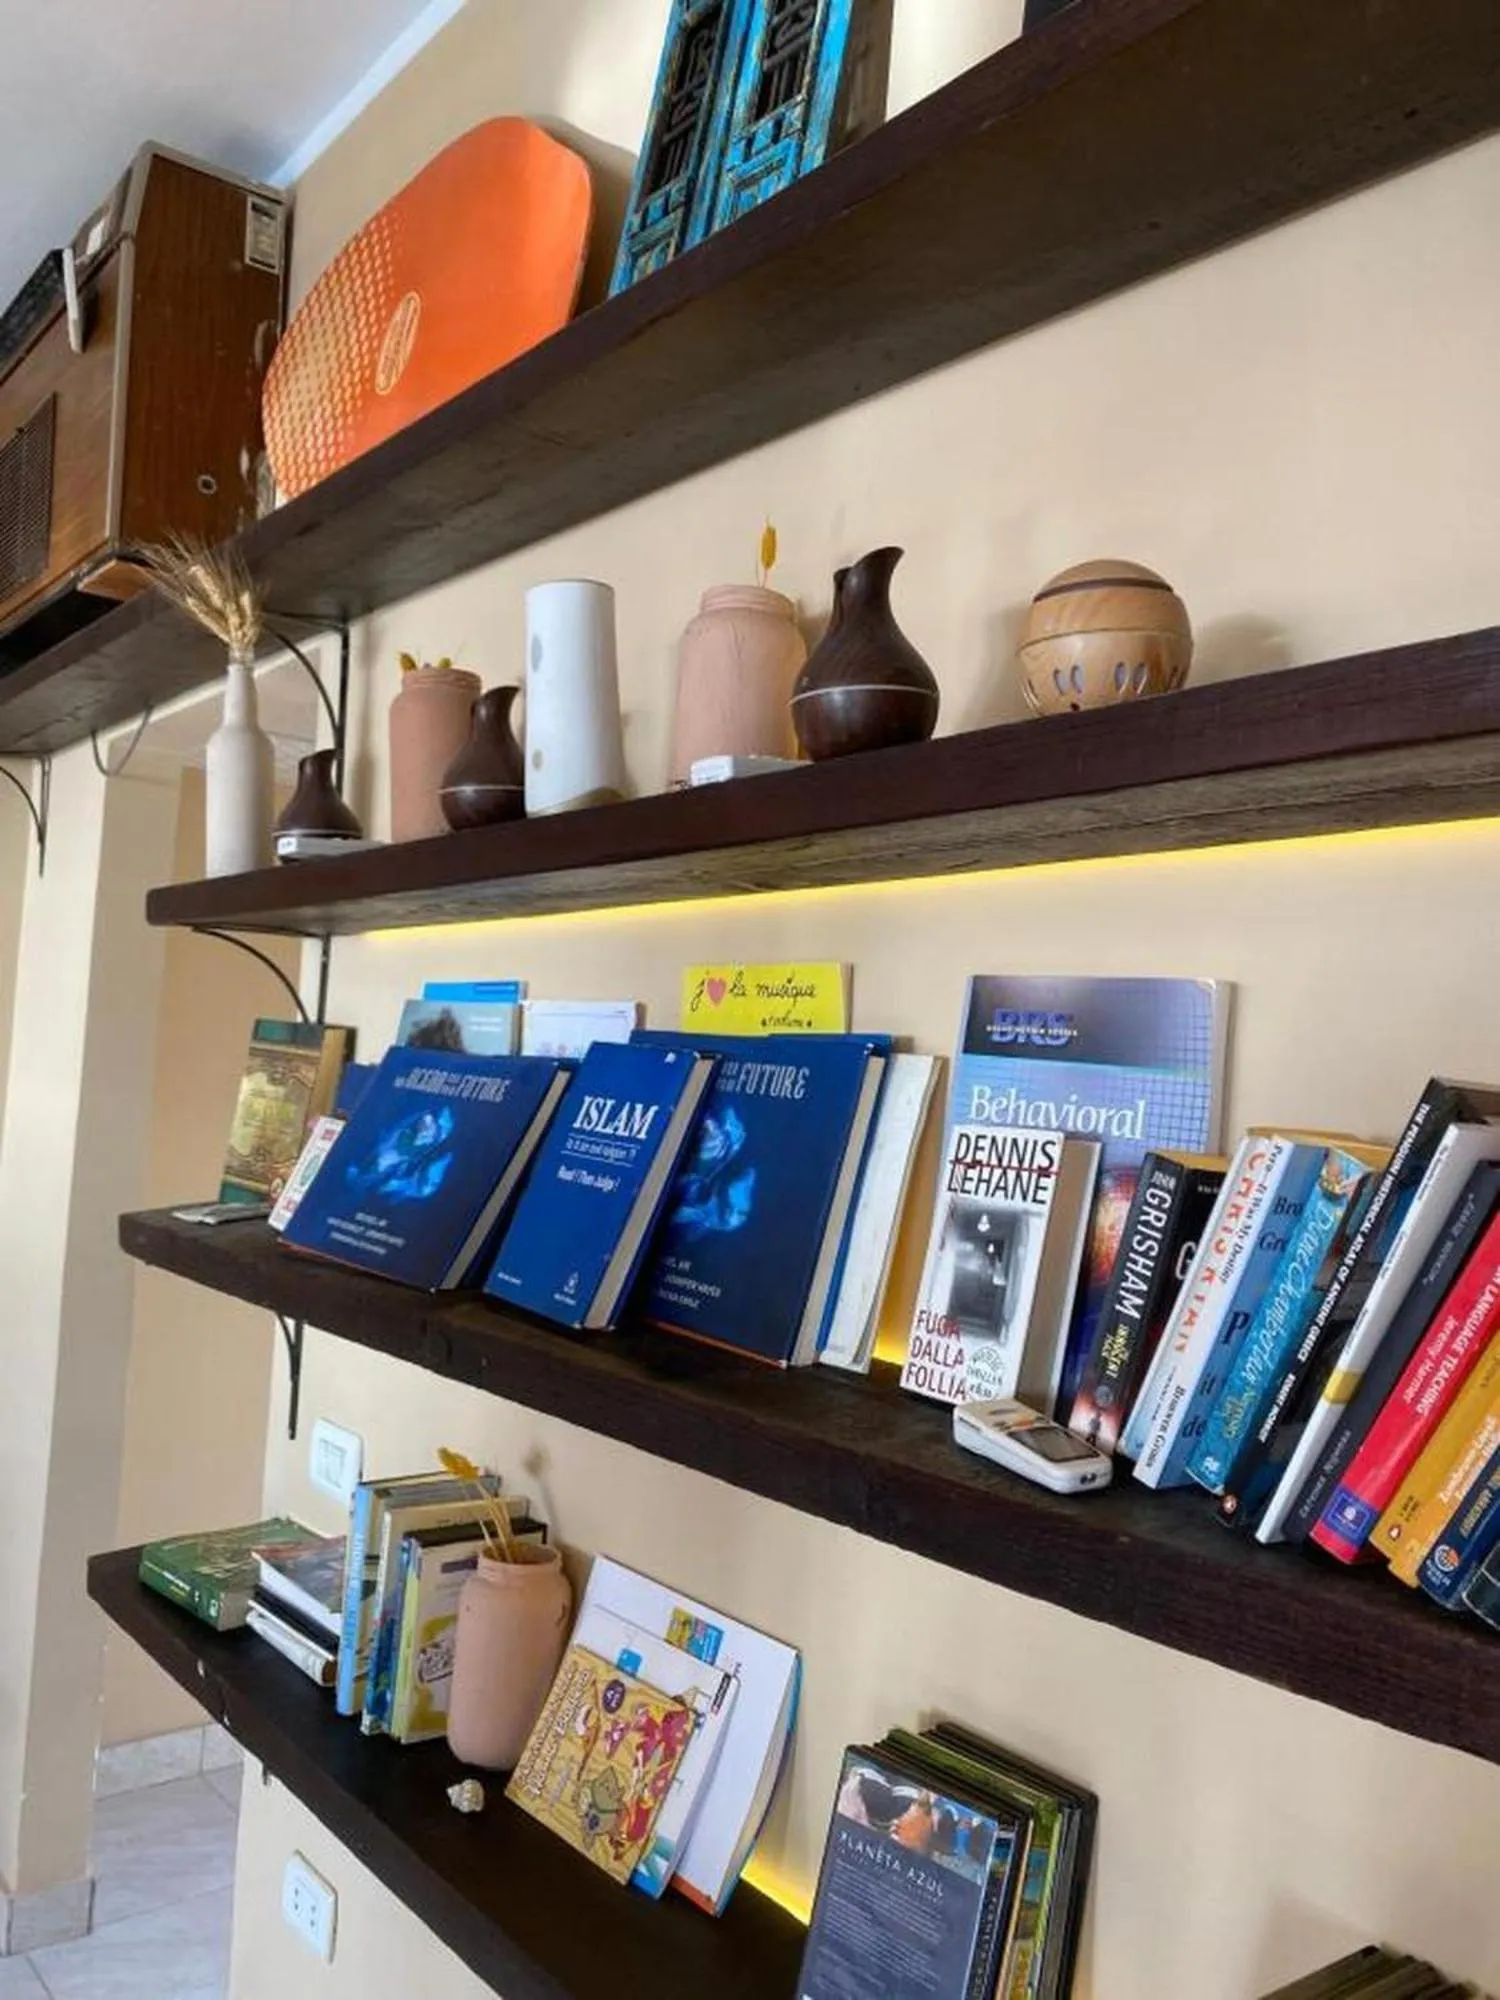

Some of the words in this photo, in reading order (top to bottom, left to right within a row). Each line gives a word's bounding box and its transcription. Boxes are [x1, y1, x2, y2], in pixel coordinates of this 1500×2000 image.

[735, 1061, 810, 1100] FUTURE
[572, 1095, 659, 1139] ISLAM
[969, 1084, 1147, 1140] Behavioral
[1413, 1102, 1431, 1124] THE
[954, 1131, 1056, 1171] DENNIS
[1388, 1123, 1420, 1175] PENGUIN
[946, 1162, 1051, 1205] LEHANE
[1359, 1173, 1395, 1234] HISTORICAL
[1114, 1188, 1172, 1320] GRISHAM
[1343, 1233, 1366, 1266] ATLAS
[1335, 1264, 1350, 1282] OF
[1313, 1280, 1342, 1326] ANCIENT
[1450, 1284, 1499, 1354] LANGUAGE
[916, 1309, 960, 1343] FUGA
[1423, 1313, 1461, 1360] Jeremy
[911, 1334, 964, 1370] DALLA
[904, 1364, 967, 1402] FOLLIA
[1399, 1357, 1436, 1405] Harmer
[1413, 1353, 1460, 1417] TEACHING
[836, 1829, 903, 1873] PLANETA
[905, 1866, 947, 1898] AZUL
